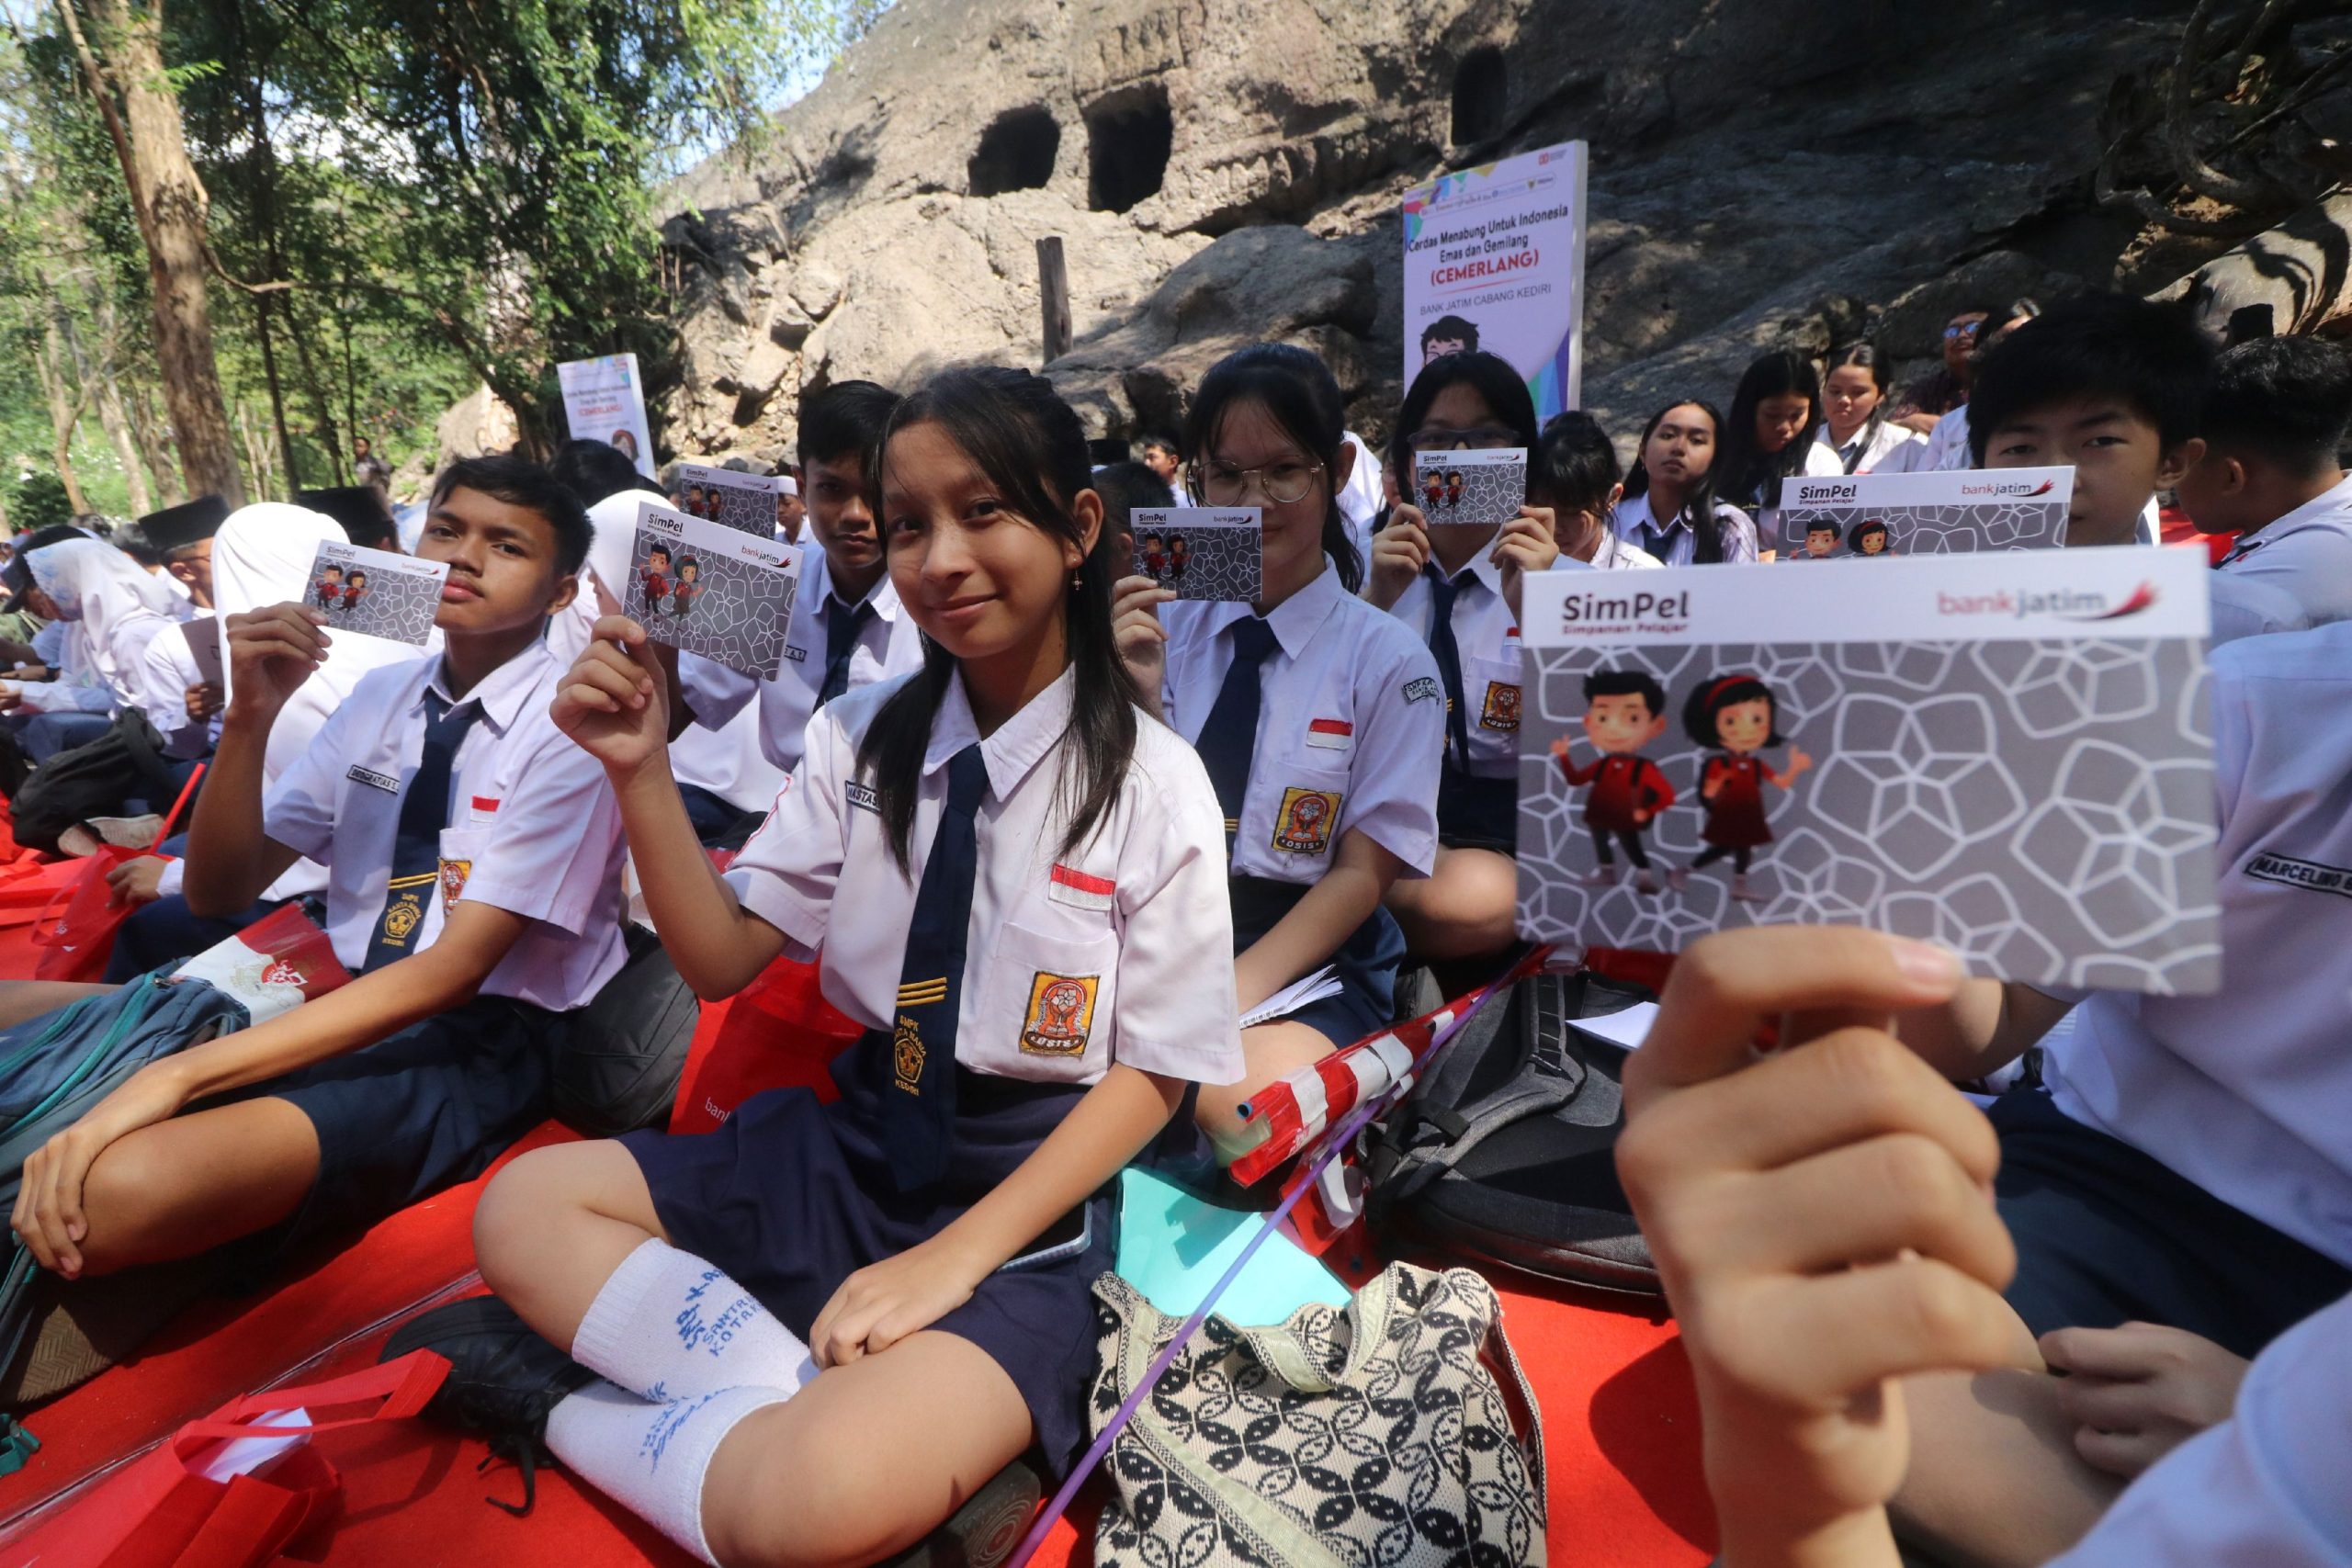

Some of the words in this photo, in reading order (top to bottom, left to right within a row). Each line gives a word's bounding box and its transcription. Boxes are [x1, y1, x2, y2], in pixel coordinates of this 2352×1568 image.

[1408, 237, 1438, 253] Cerdas
[1440, 224, 1486, 245] Menabung
[1487, 216, 1517, 234] Untuk
[1520, 204, 1568, 226] Indonesia
[1440, 249, 1464, 263] Emas
[1465, 244, 1481, 258] dan
[1484, 234, 1529, 254] Gemilang
[1430, 249, 1540, 287] (CEMERLANG)
[1420, 302, 1444, 316] BANK
[1445, 297, 1472, 311] JATIM
[1474, 289, 1515, 307] CABANG
[1517, 283, 1552, 299] KEDIRI
[1423, 455, 1447, 463] SimPel
[686, 468, 708, 479] SimPel
[1799, 484, 1857, 499] SimPel
[1962, 482, 2032, 497] bankjatim
[648, 513, 684, 533] SimPel
[1138, 513, 1167, 522] SimPel
[326, 546, 355, 558] SimPel
[741, 544, 780, 564] bankjatim
[1562, 591, 1688, 621] SimPel
[1937, 588, 2108, 621] bankjatim
[1286, 840, 1315, 850] OSIS
[2253, 856, 2342, 887] MARCELINO
[1036, 1037, 1071, 1048] OSIS
